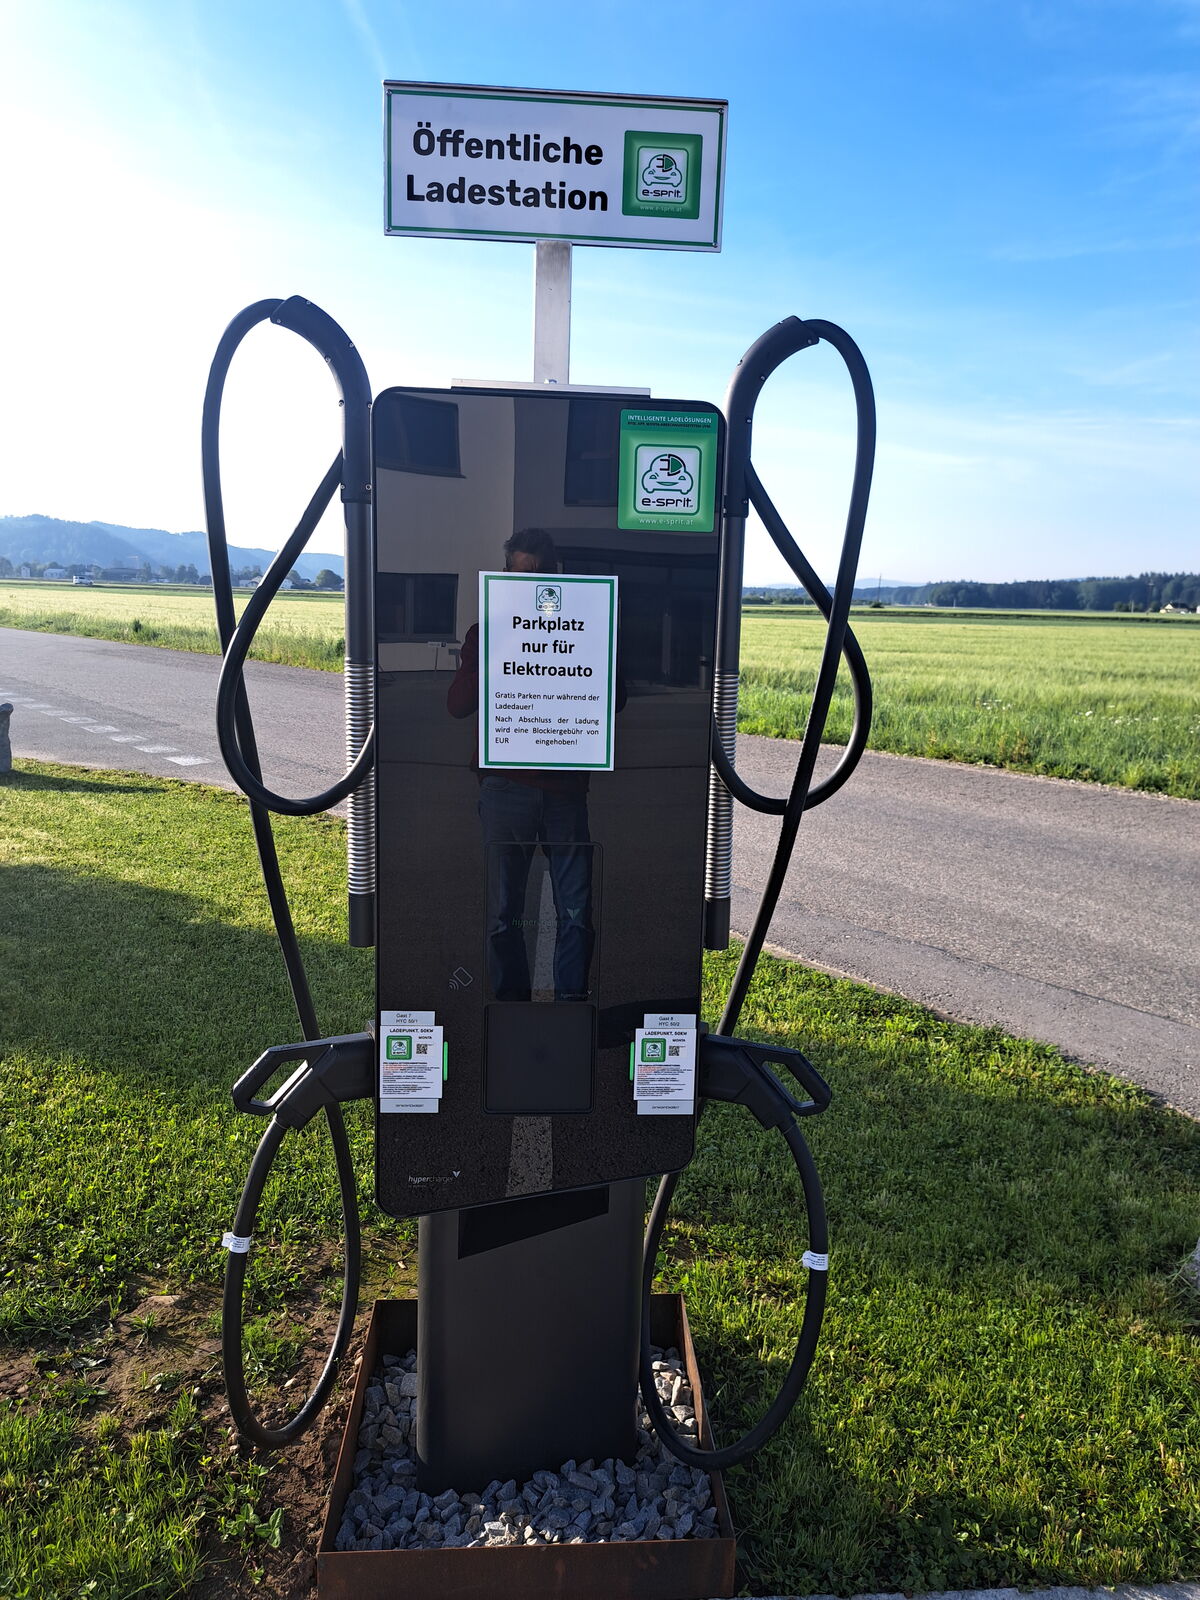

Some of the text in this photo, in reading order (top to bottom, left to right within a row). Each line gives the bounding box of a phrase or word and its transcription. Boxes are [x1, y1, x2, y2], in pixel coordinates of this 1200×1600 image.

[412, 121, 604, 165] Öffentliche
[406, 174, 608, 212] Ladestation
[667, 416, 712, 424] LADELÖSUNGEN
[641, 497, 692, 508] e-sprit
[639, 518, 694, 526] www.e-sprit.at
[512, 616, 585, 633] Parkplatz
[522, 640, 575, 654] nur für
[503, 661, 593, 677] Elektroauto
[517, 692, 541, 700] Parken
[575, 717, 599, 726] Ladung
[532, 727, 583, 736] Blockiergebühr
[535, 738, 578, 746] eingehoben!
